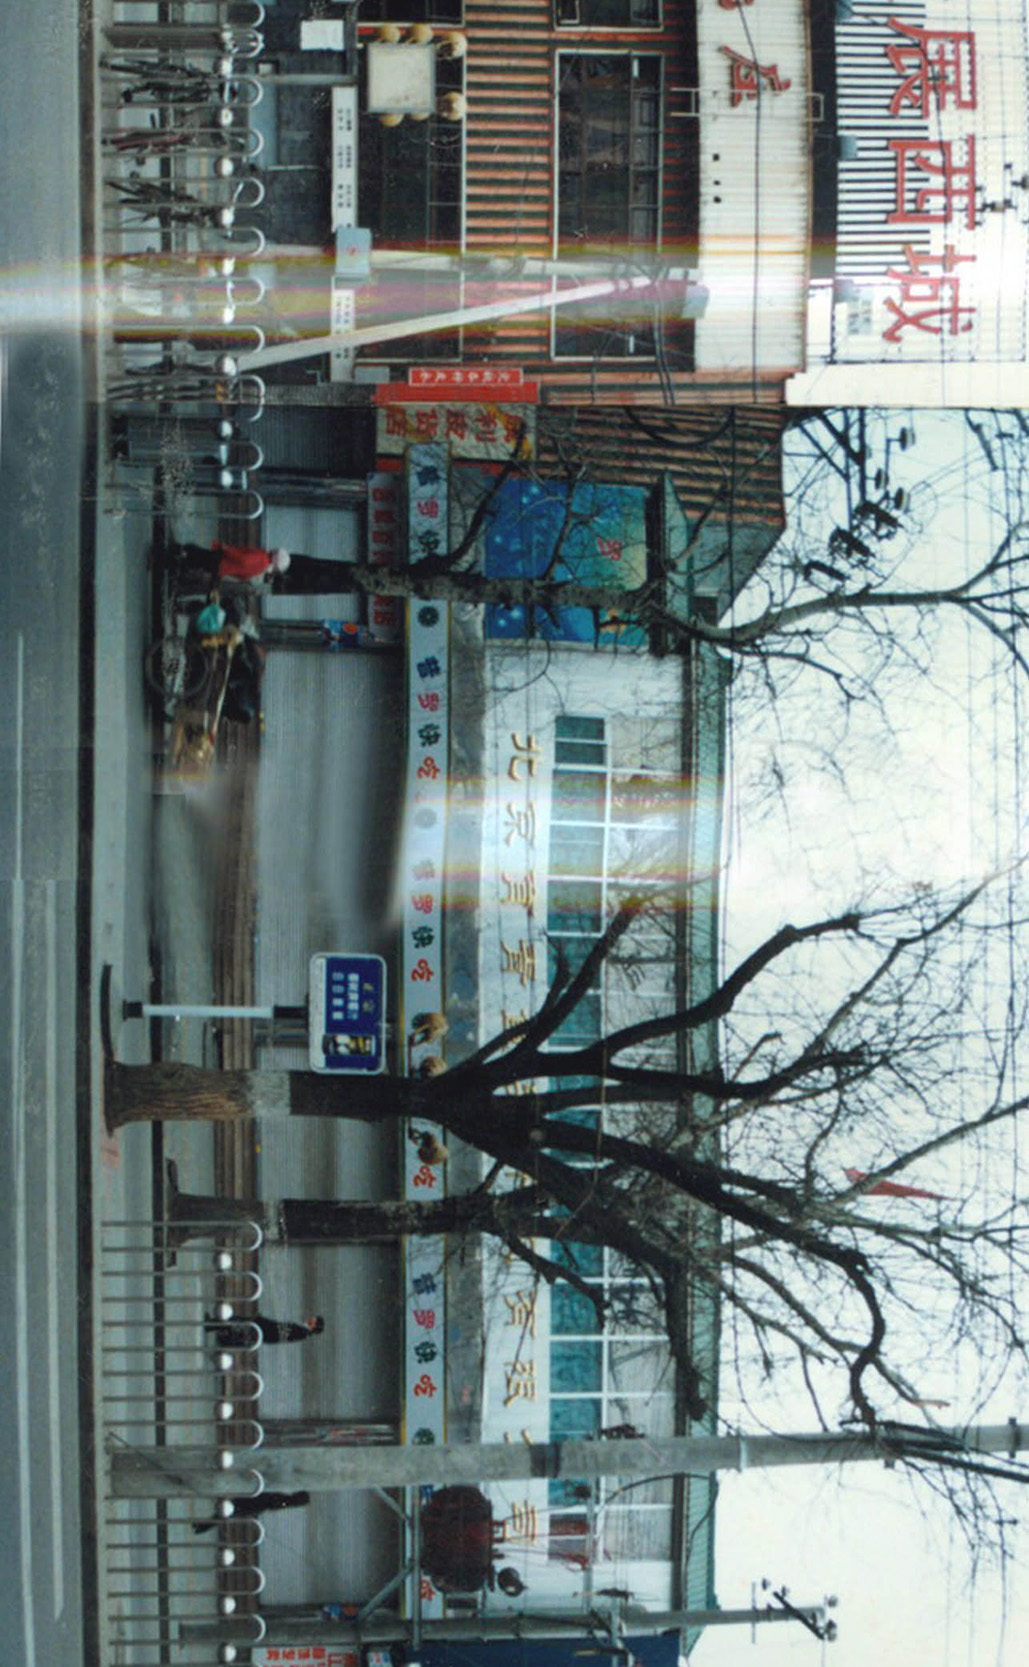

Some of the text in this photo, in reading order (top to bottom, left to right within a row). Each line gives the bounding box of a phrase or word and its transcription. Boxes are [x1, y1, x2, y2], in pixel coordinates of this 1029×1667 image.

[718, 0, 792, 108] 庄
[413, 465, 445, 555] 普罗快
[499, 733, 543, 1546] 北京育青有限司
